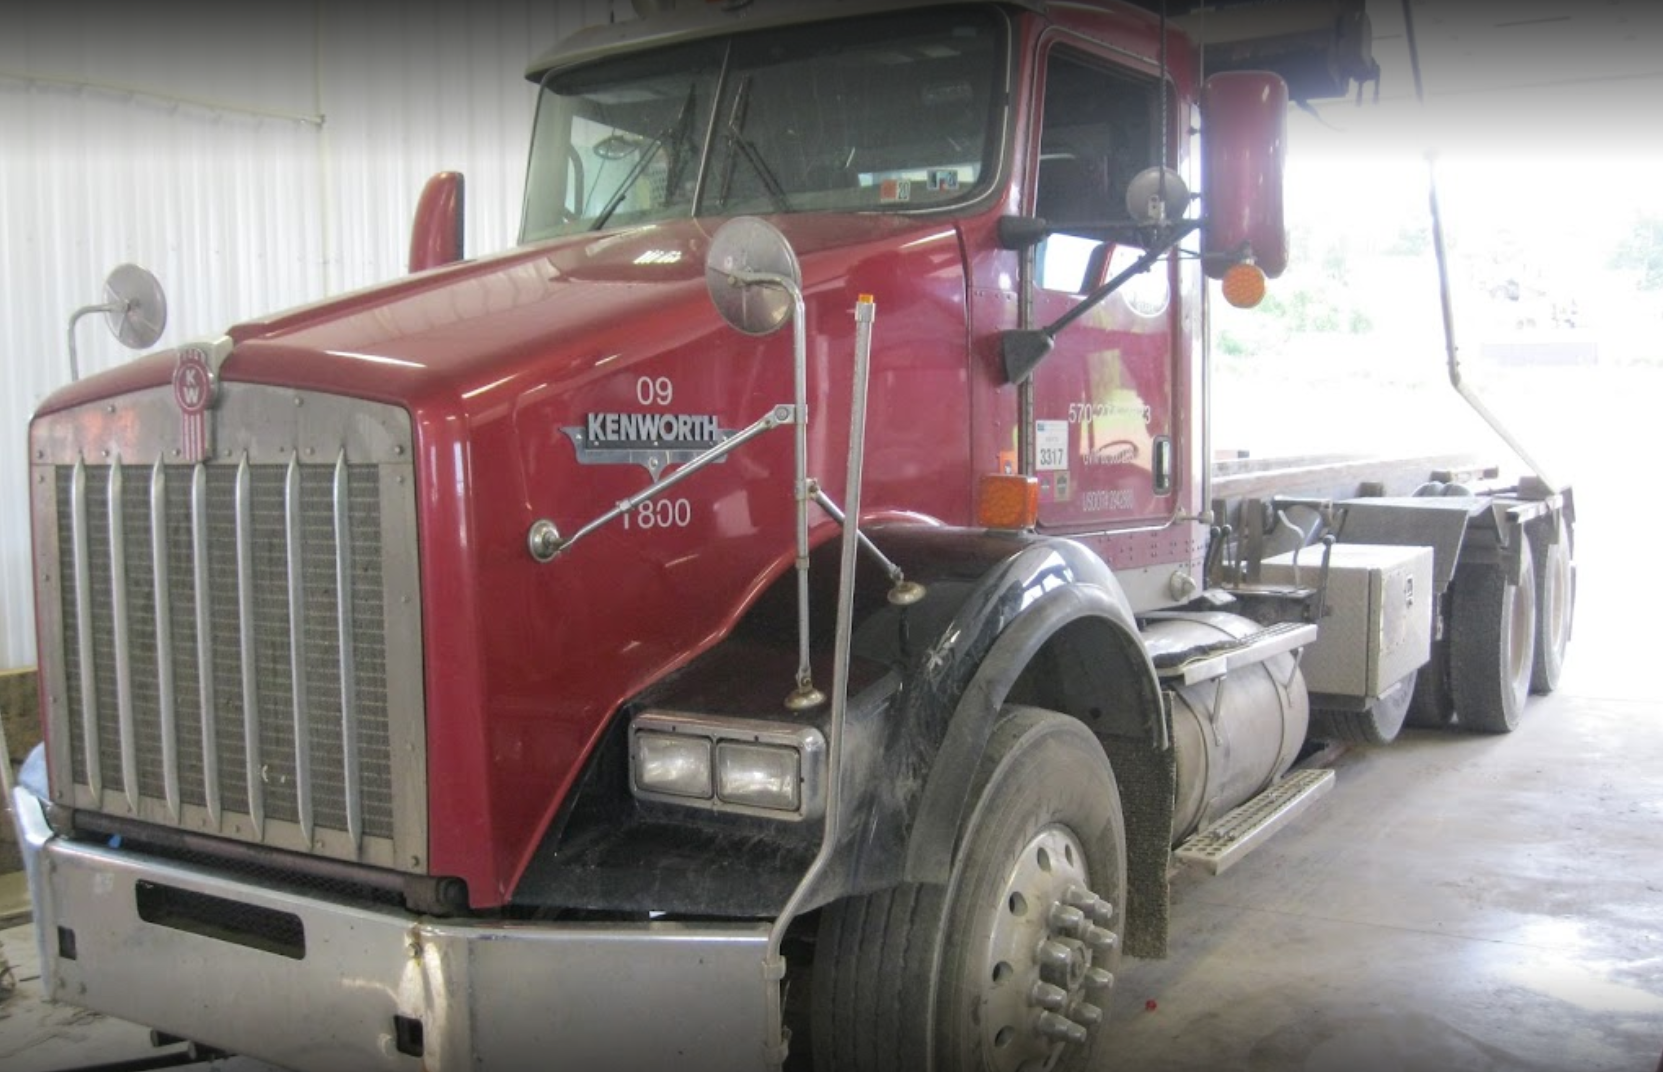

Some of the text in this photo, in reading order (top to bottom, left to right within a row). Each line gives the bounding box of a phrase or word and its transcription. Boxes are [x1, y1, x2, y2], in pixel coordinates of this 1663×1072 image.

[636, 376, 673, 405] 09
[588, 413, 718, 441] KENWORTH
[1040, 447, 1064, 466] 3317
